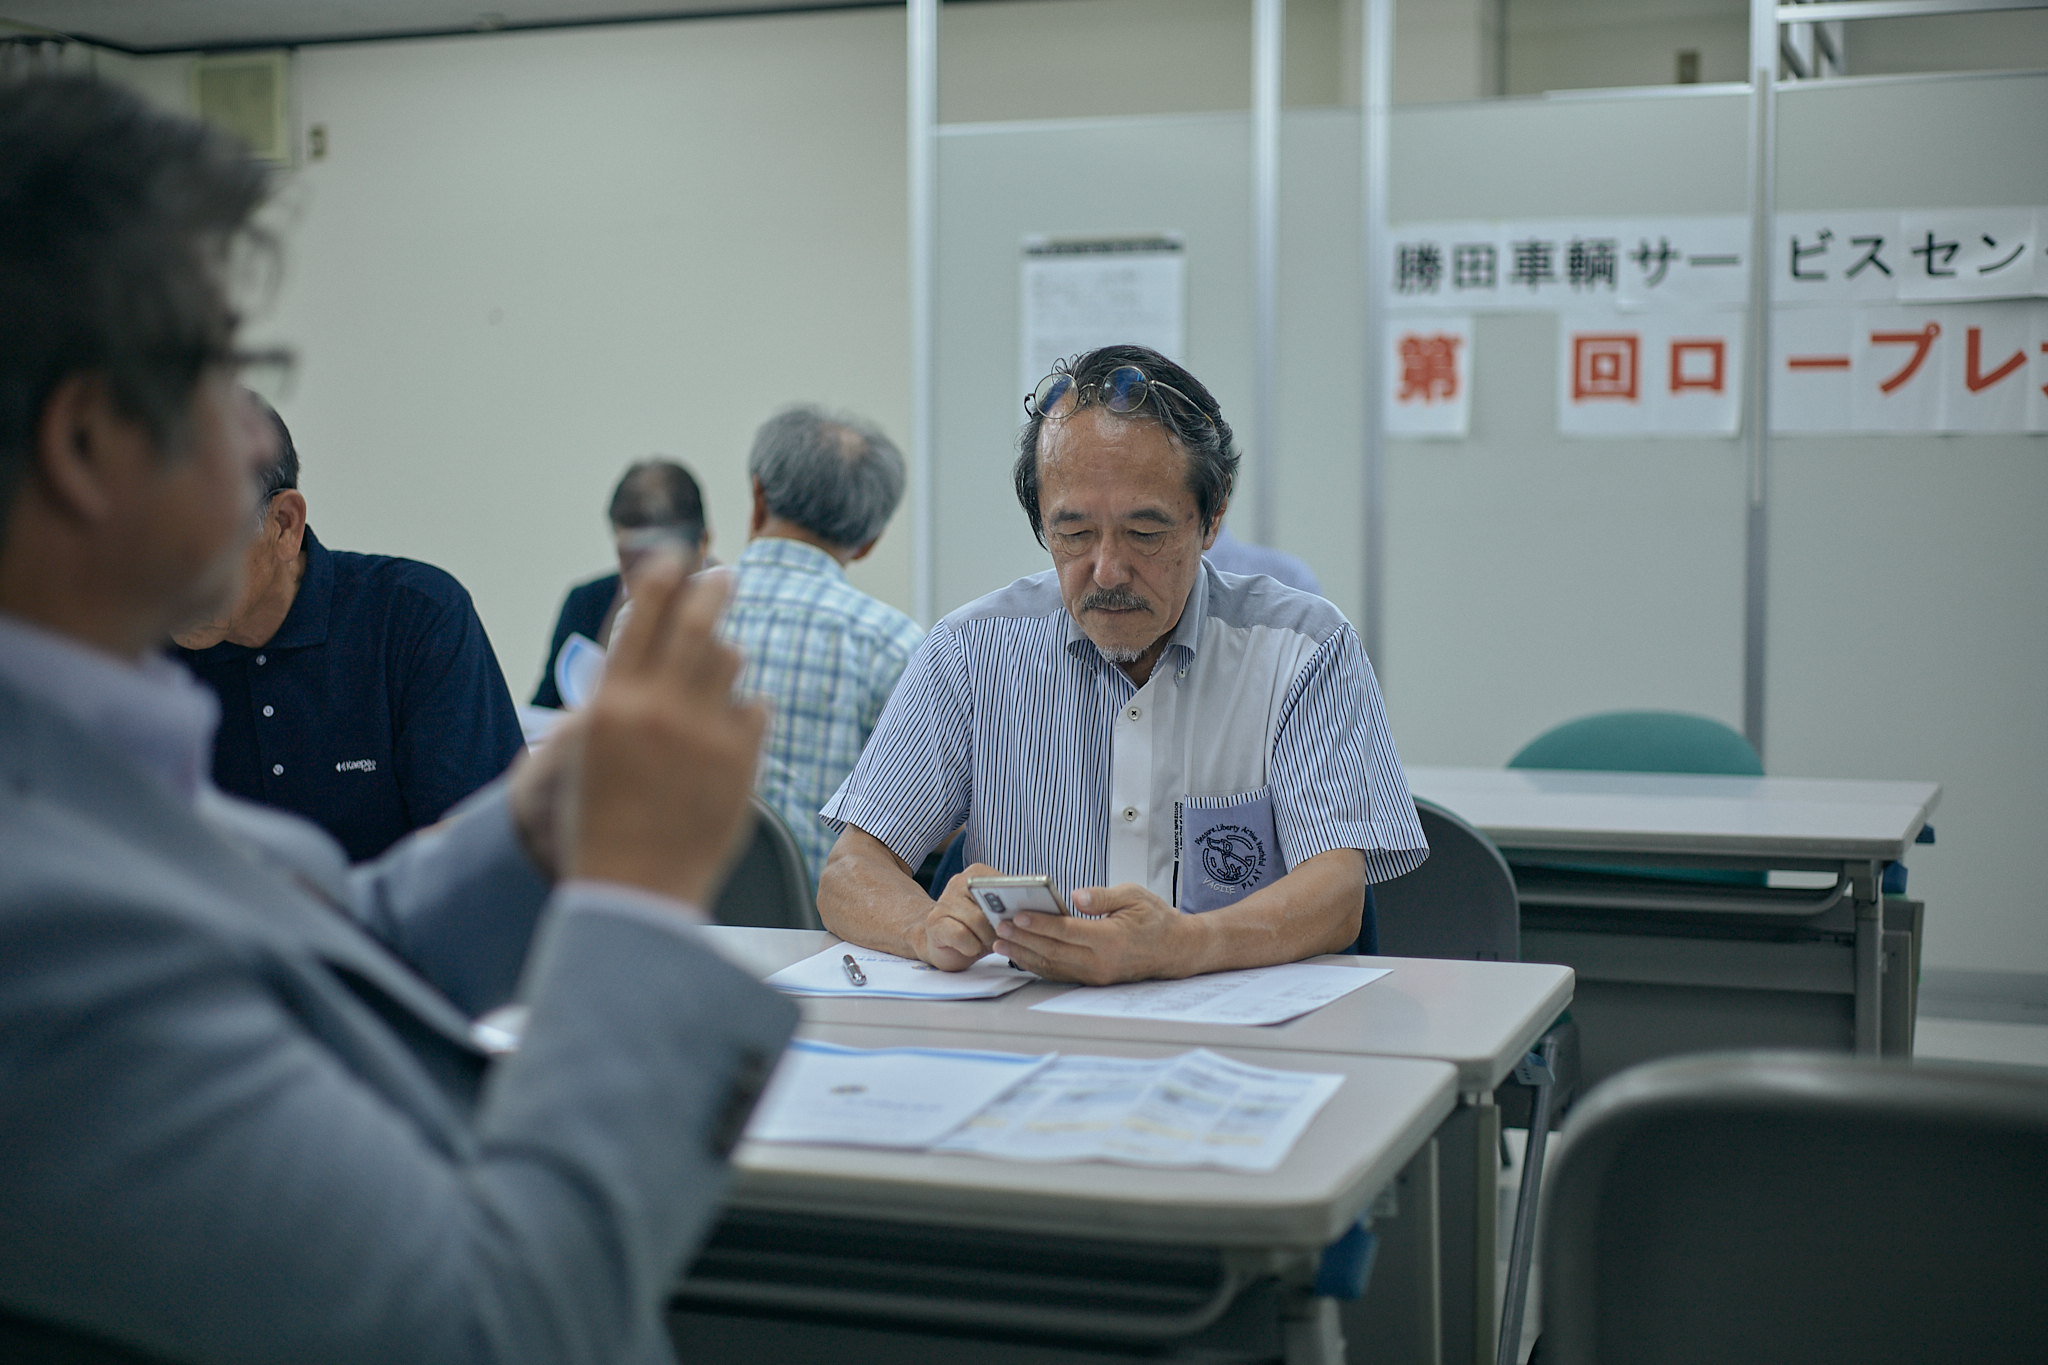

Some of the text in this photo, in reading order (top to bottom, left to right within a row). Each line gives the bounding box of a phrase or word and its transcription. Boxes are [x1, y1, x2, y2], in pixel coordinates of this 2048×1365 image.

[1395, 332, 1463, 403] 第
[1215, 823, 1240, 834] Liberty
[1240, 826, 1258, 841] Active
[1241, 869, 1263, 891] PLAY
